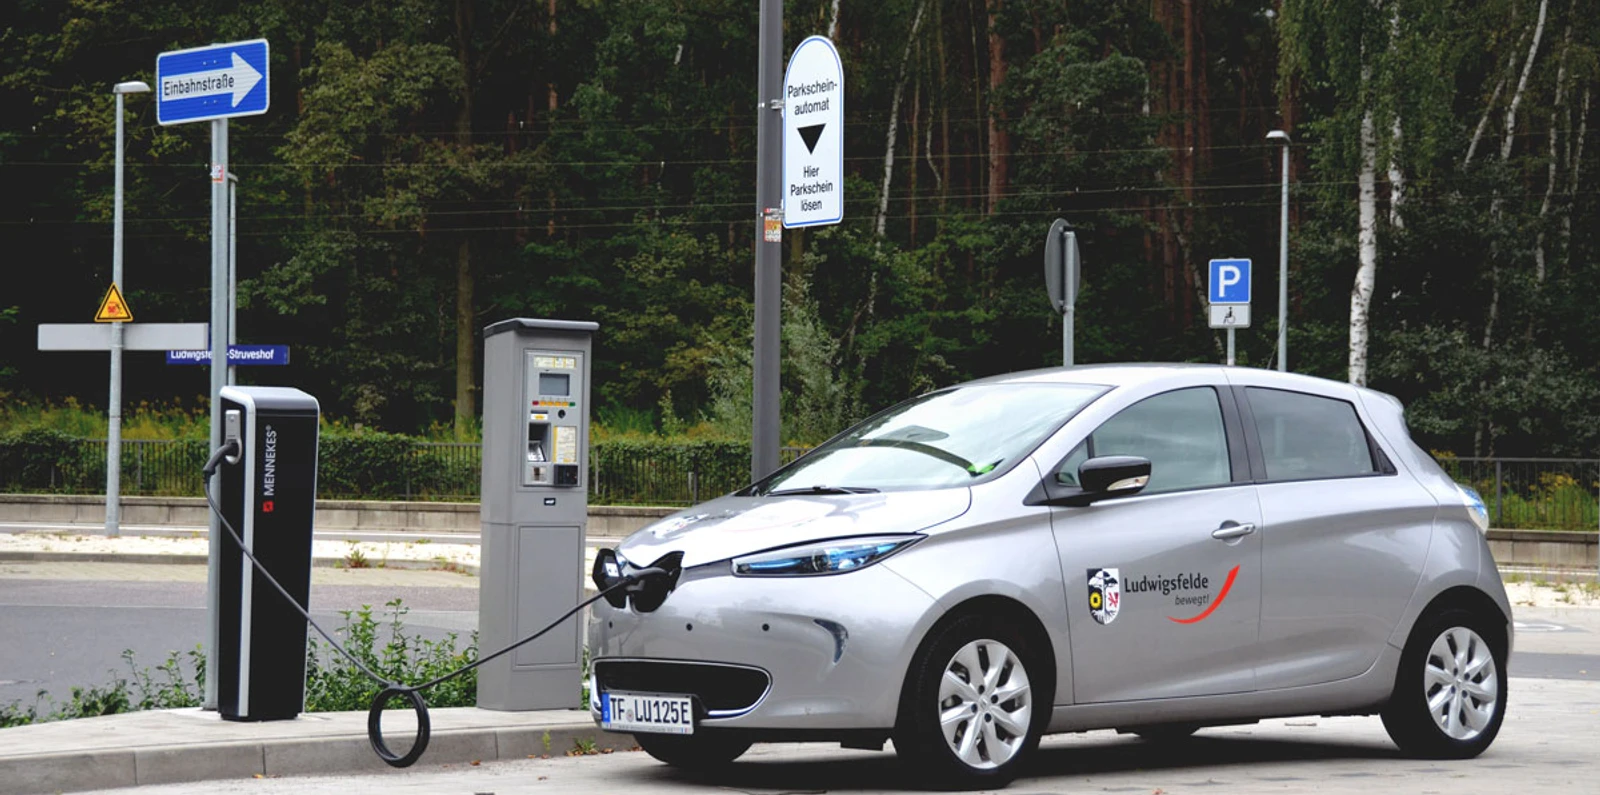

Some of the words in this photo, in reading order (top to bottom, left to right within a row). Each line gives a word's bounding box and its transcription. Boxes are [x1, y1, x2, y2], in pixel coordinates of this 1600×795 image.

[164, 73, 235, 96] Einbahnstraße
[787, 78, 838, 98] Parkschein-
[794, 97, 830, 116] automat
[803, 166, 820, 178] Hier
[790, 180, 833, 196] Parkschein
[801, 199, 822, 212] lösen
[1218, 265, 1241, 298] P
[1124, 573, 1209, 596] Ludwigsfelde
[1175, 594, 1210, 606] bewegt!
[610, 697, 625, 720] TF
